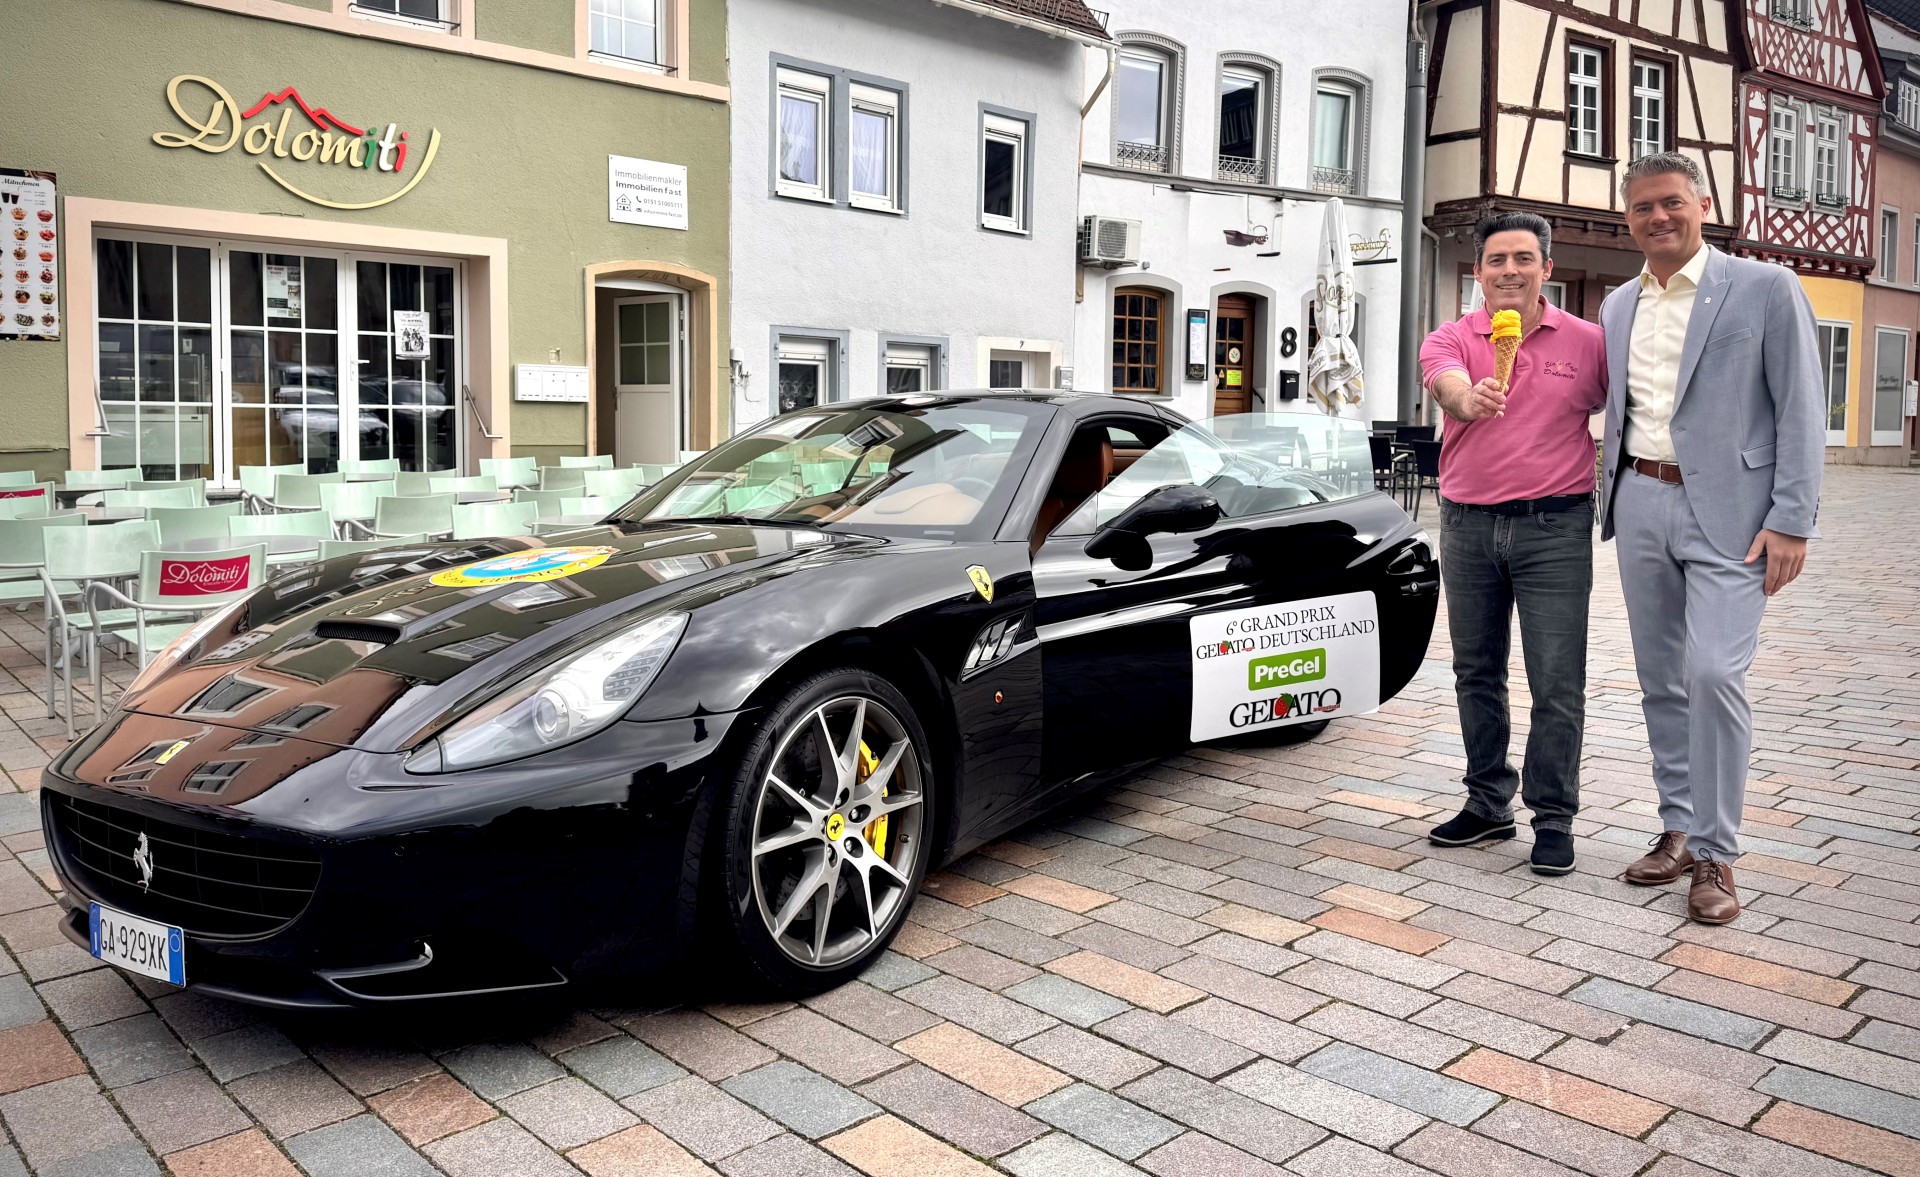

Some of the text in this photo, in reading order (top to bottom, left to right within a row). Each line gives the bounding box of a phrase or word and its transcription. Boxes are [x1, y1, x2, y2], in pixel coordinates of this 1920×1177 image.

[152, 74, 408, 172] Dolomiti
[614, 169, 682, 186] Immobilienmakler
[615, 180, 682, 196] Immobilien fast
[1281, 326, 1298, 358] 8
[162, 562, 241, 585] Dolomiti
[1240, 611, 1298, 633] GRAND
[1301, 605, 1336, 624] PRIX
[1196, 619, 1375, 660] GELATO DEUTSCHLAND
[1254, 655, 1320, 683] PreGel
[1229, 688, 1342, 728] GELATO
